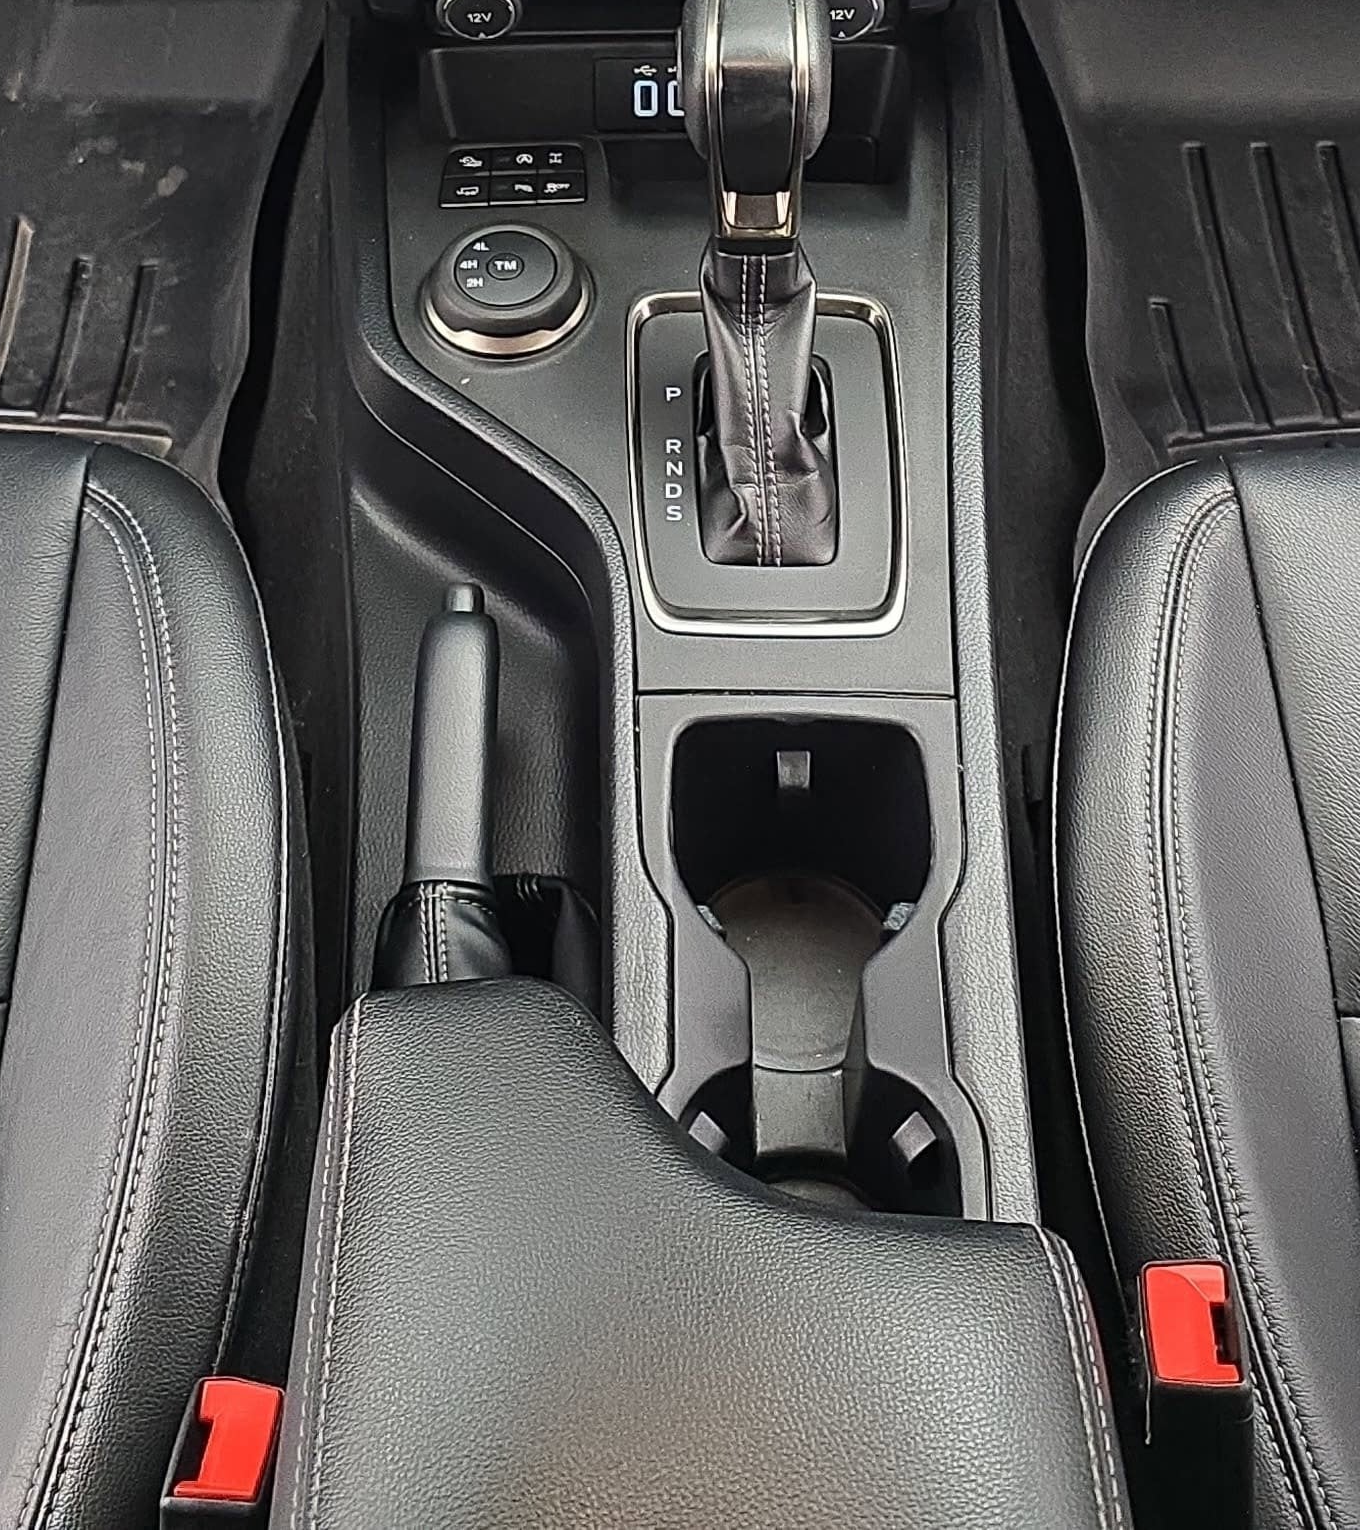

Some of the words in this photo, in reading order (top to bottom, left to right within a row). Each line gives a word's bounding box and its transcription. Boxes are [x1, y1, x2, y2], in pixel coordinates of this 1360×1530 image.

[466, 11, 493, 24] 12V
[829, 7, 856, 21] 12V
[472, 242, 490, 252] 4L
[459, 259, 478, 270] 4H
[494, 259, 518, 271] TM
[466, 277, 484, 288] 2H
[665, 387, 682, 402] P
[665, 438, 682, 455] R
[665, 461, 682, 477] N
[665, 483, 682, 500] D
[665, 506, 683, 522] S
